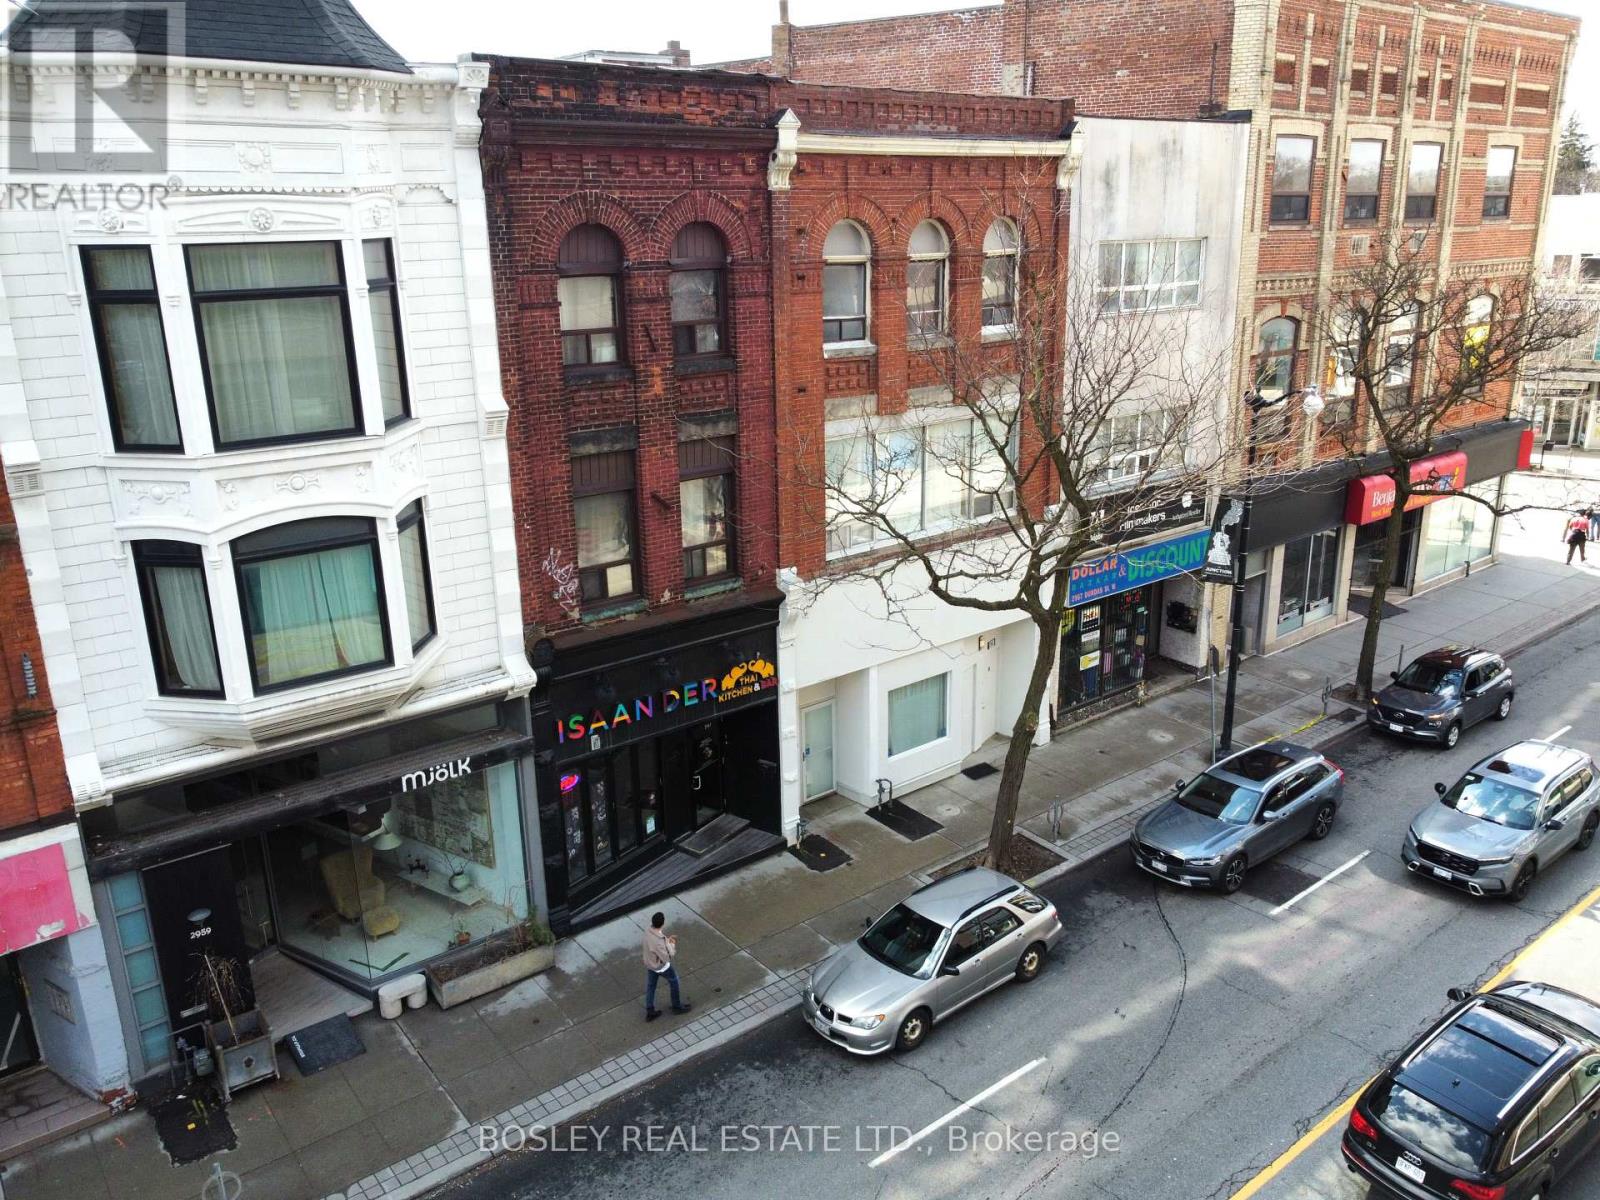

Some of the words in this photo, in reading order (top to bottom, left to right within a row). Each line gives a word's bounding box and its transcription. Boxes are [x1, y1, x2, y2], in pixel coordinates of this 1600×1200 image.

[1071, 559, 1118, 581] DOLLAR
[1119, 563, 1127, 577] &
[1205, 566, 1232, 575] JUNCTION
[740, 673, 759, 686] THAI
[718, 685, 754, 704] KITCHEN
[753, 682, 761, 692] &
[761, 677, 778, 690] BAR
[557, 695, 653, 744] ISAAN
[663, 678, 719, 714] DER
[190, 927, 212, 940] 2959
